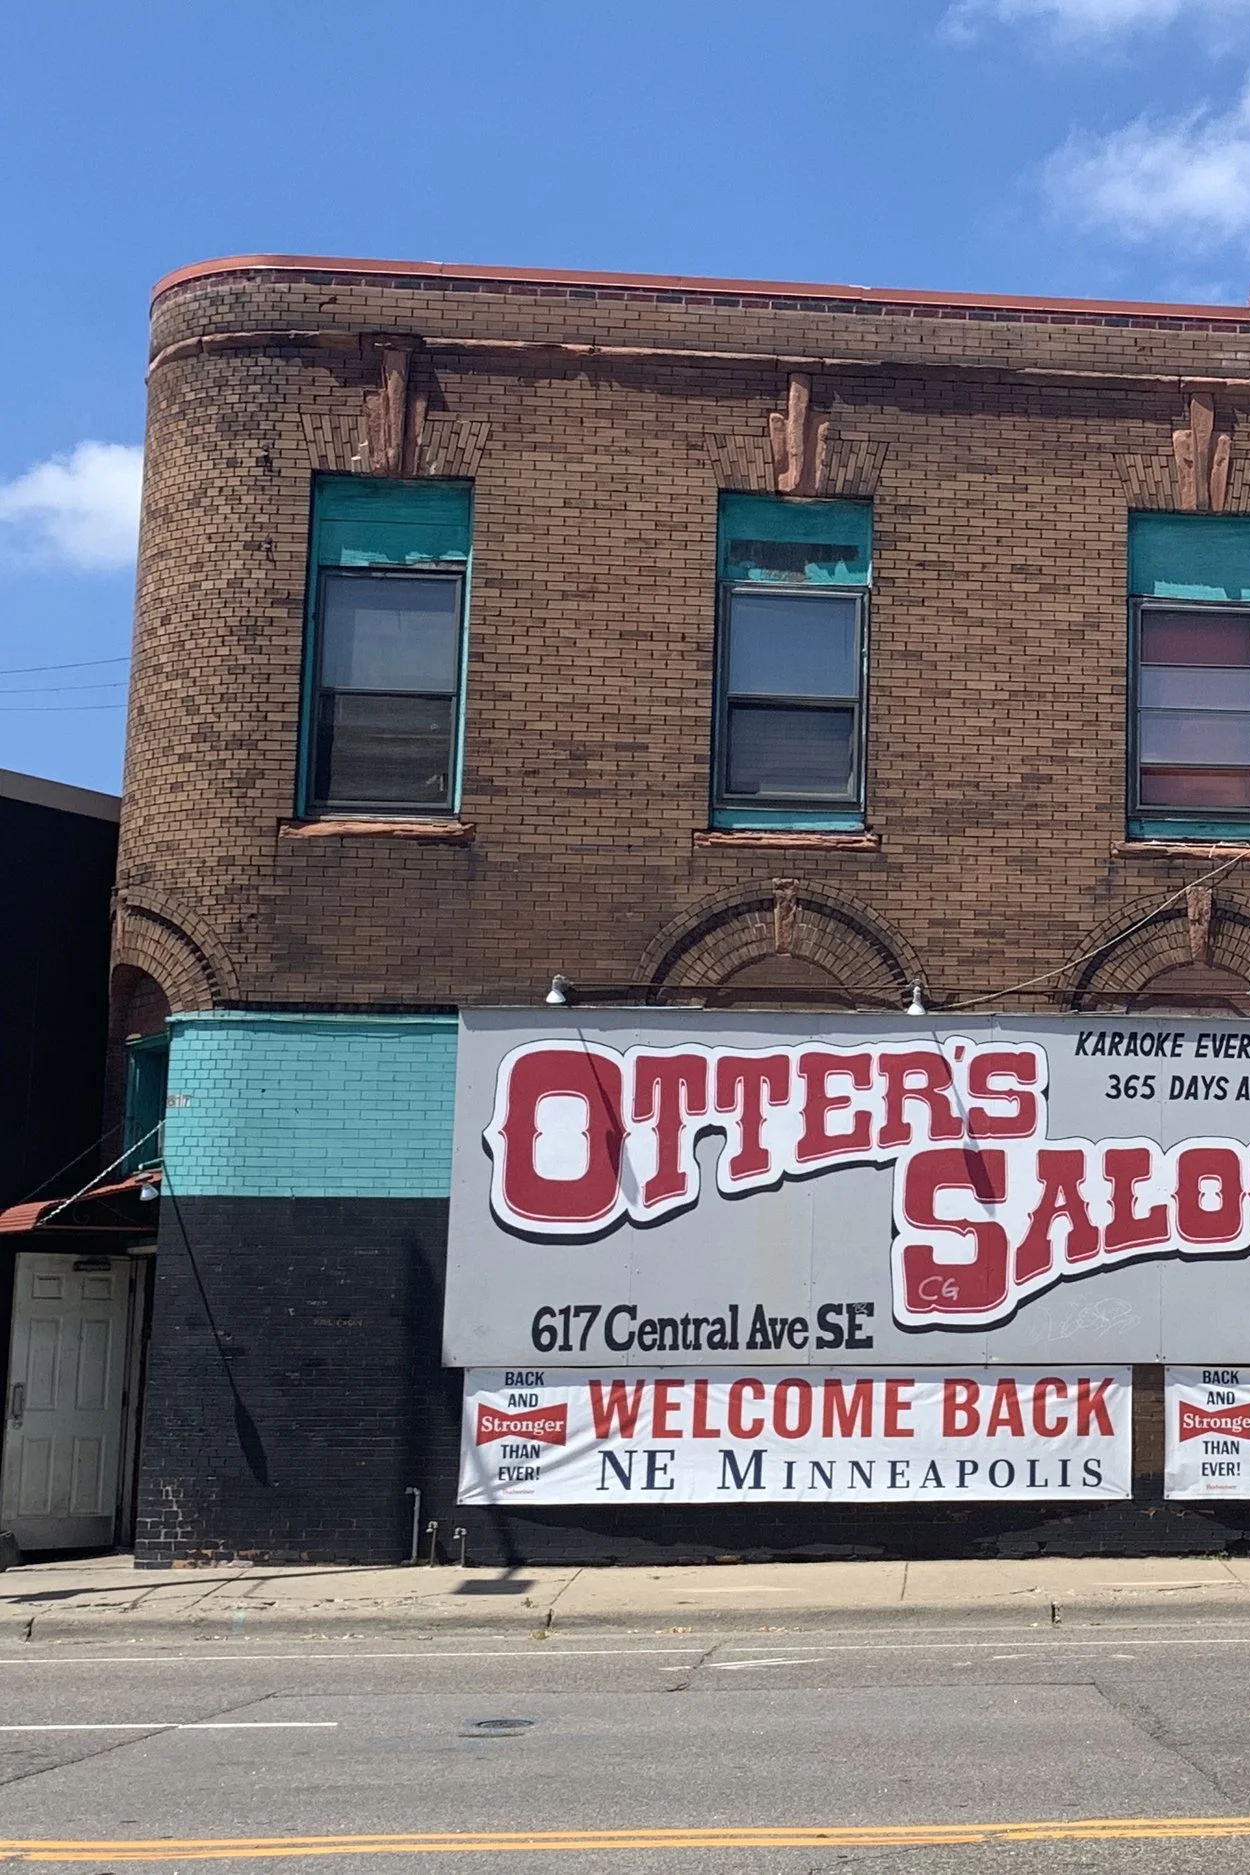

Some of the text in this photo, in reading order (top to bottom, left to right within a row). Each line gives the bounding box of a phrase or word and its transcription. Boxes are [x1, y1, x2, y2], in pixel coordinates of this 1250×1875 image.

[1075, 1031, 1185, 1058] KARAOKE
[1105, 1074, 1156, 1100] 365
[1169, 1075, 1229, 1101] DAYS
[1235, 1076, 1250, 1101] A
[496, 1044, 1038, 1223] OTTER'S
[531, 1302, 875, 1352] 617 Central Ave SE
[504, 1371, 545, 1387] BACK
[1202, 1370, 1240, 1385] BACK
[507, 1393, 539, 1408] AND
[1206, 1390, 1236, 1405] AND
[588, 1375, 1116, 1440] WELCOME BACK
[480, 1415, 564, 1435] Stronger
[501, 1444, 541, 1459] THAN
[1202, 1440, 1240, 1455] THAN
[498, 1466, 540, 1481] EVER!
[596, 1447, 1104, 1492] NE MINNEAPOLIS
[1201, 1461, 1241, 1477] EVER!
